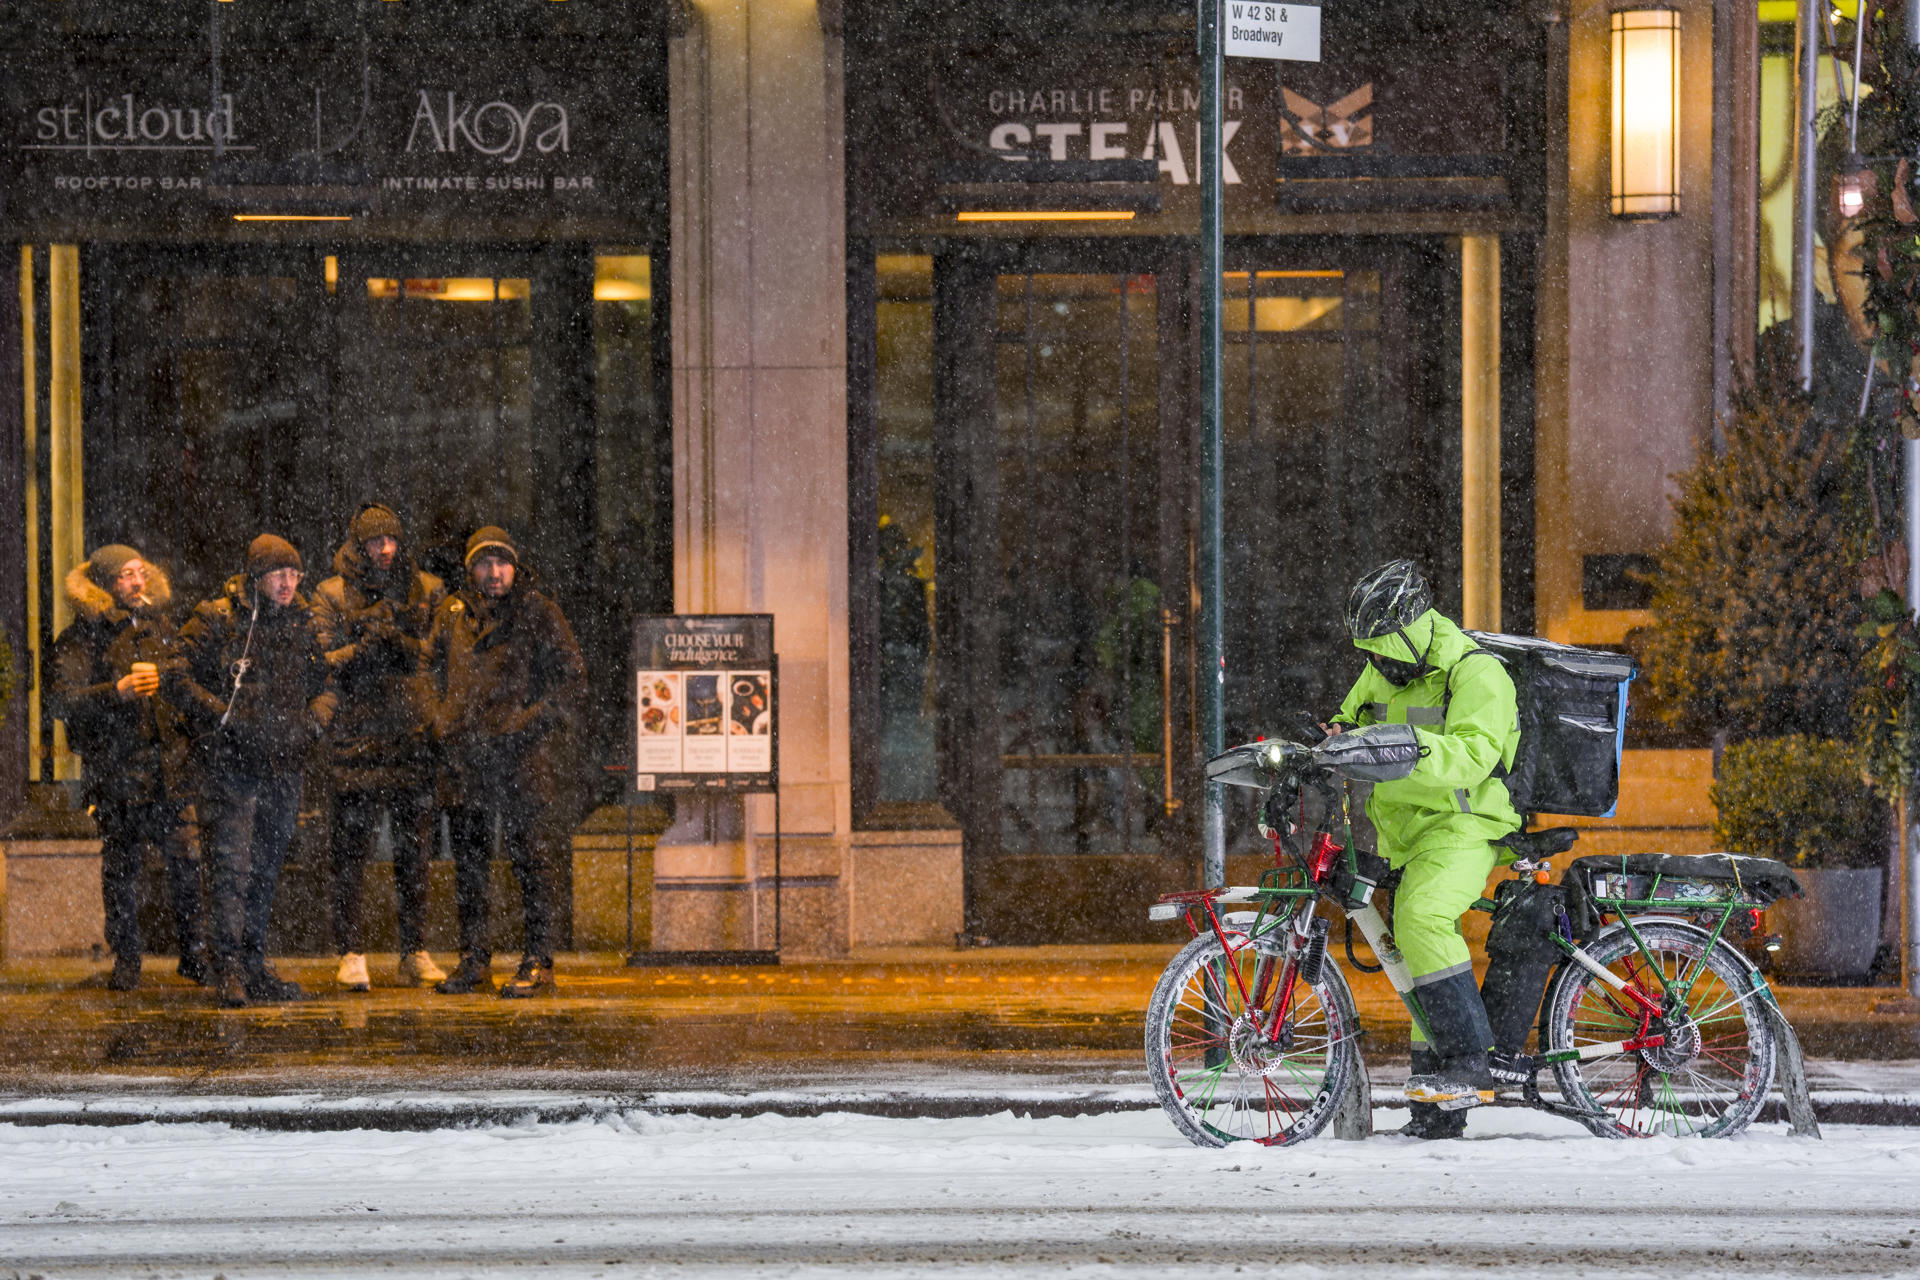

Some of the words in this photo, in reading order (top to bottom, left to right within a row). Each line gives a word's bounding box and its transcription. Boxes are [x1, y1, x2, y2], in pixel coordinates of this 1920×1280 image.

[1232, 4, 1243, 20] W
[1247, 5, 1261, 21] 42
[1264, 6, 1276, 22] St
[1280, 7, 1288, 23] &
[1231, 25, 1284, 47] Broadway
[988, 88, 1114, 115] CHARLIE
[1129, 87, 1244, 113] PALMR
[405, 88, 570, 164] Akoya
[988, 120, 1243, 185] STEAK
[54, 176, 151, 190] ROOFTOP
[161, 176, 202, 190] BAR
[382, 176, 477, 191] INTIMATE
[485, 175, 544, 191] SUSHI
[553, 175, 595, 190] BAR
[664, 633, 711, 649] CHOOSE
[711, 633, 744, 649] YOUR
